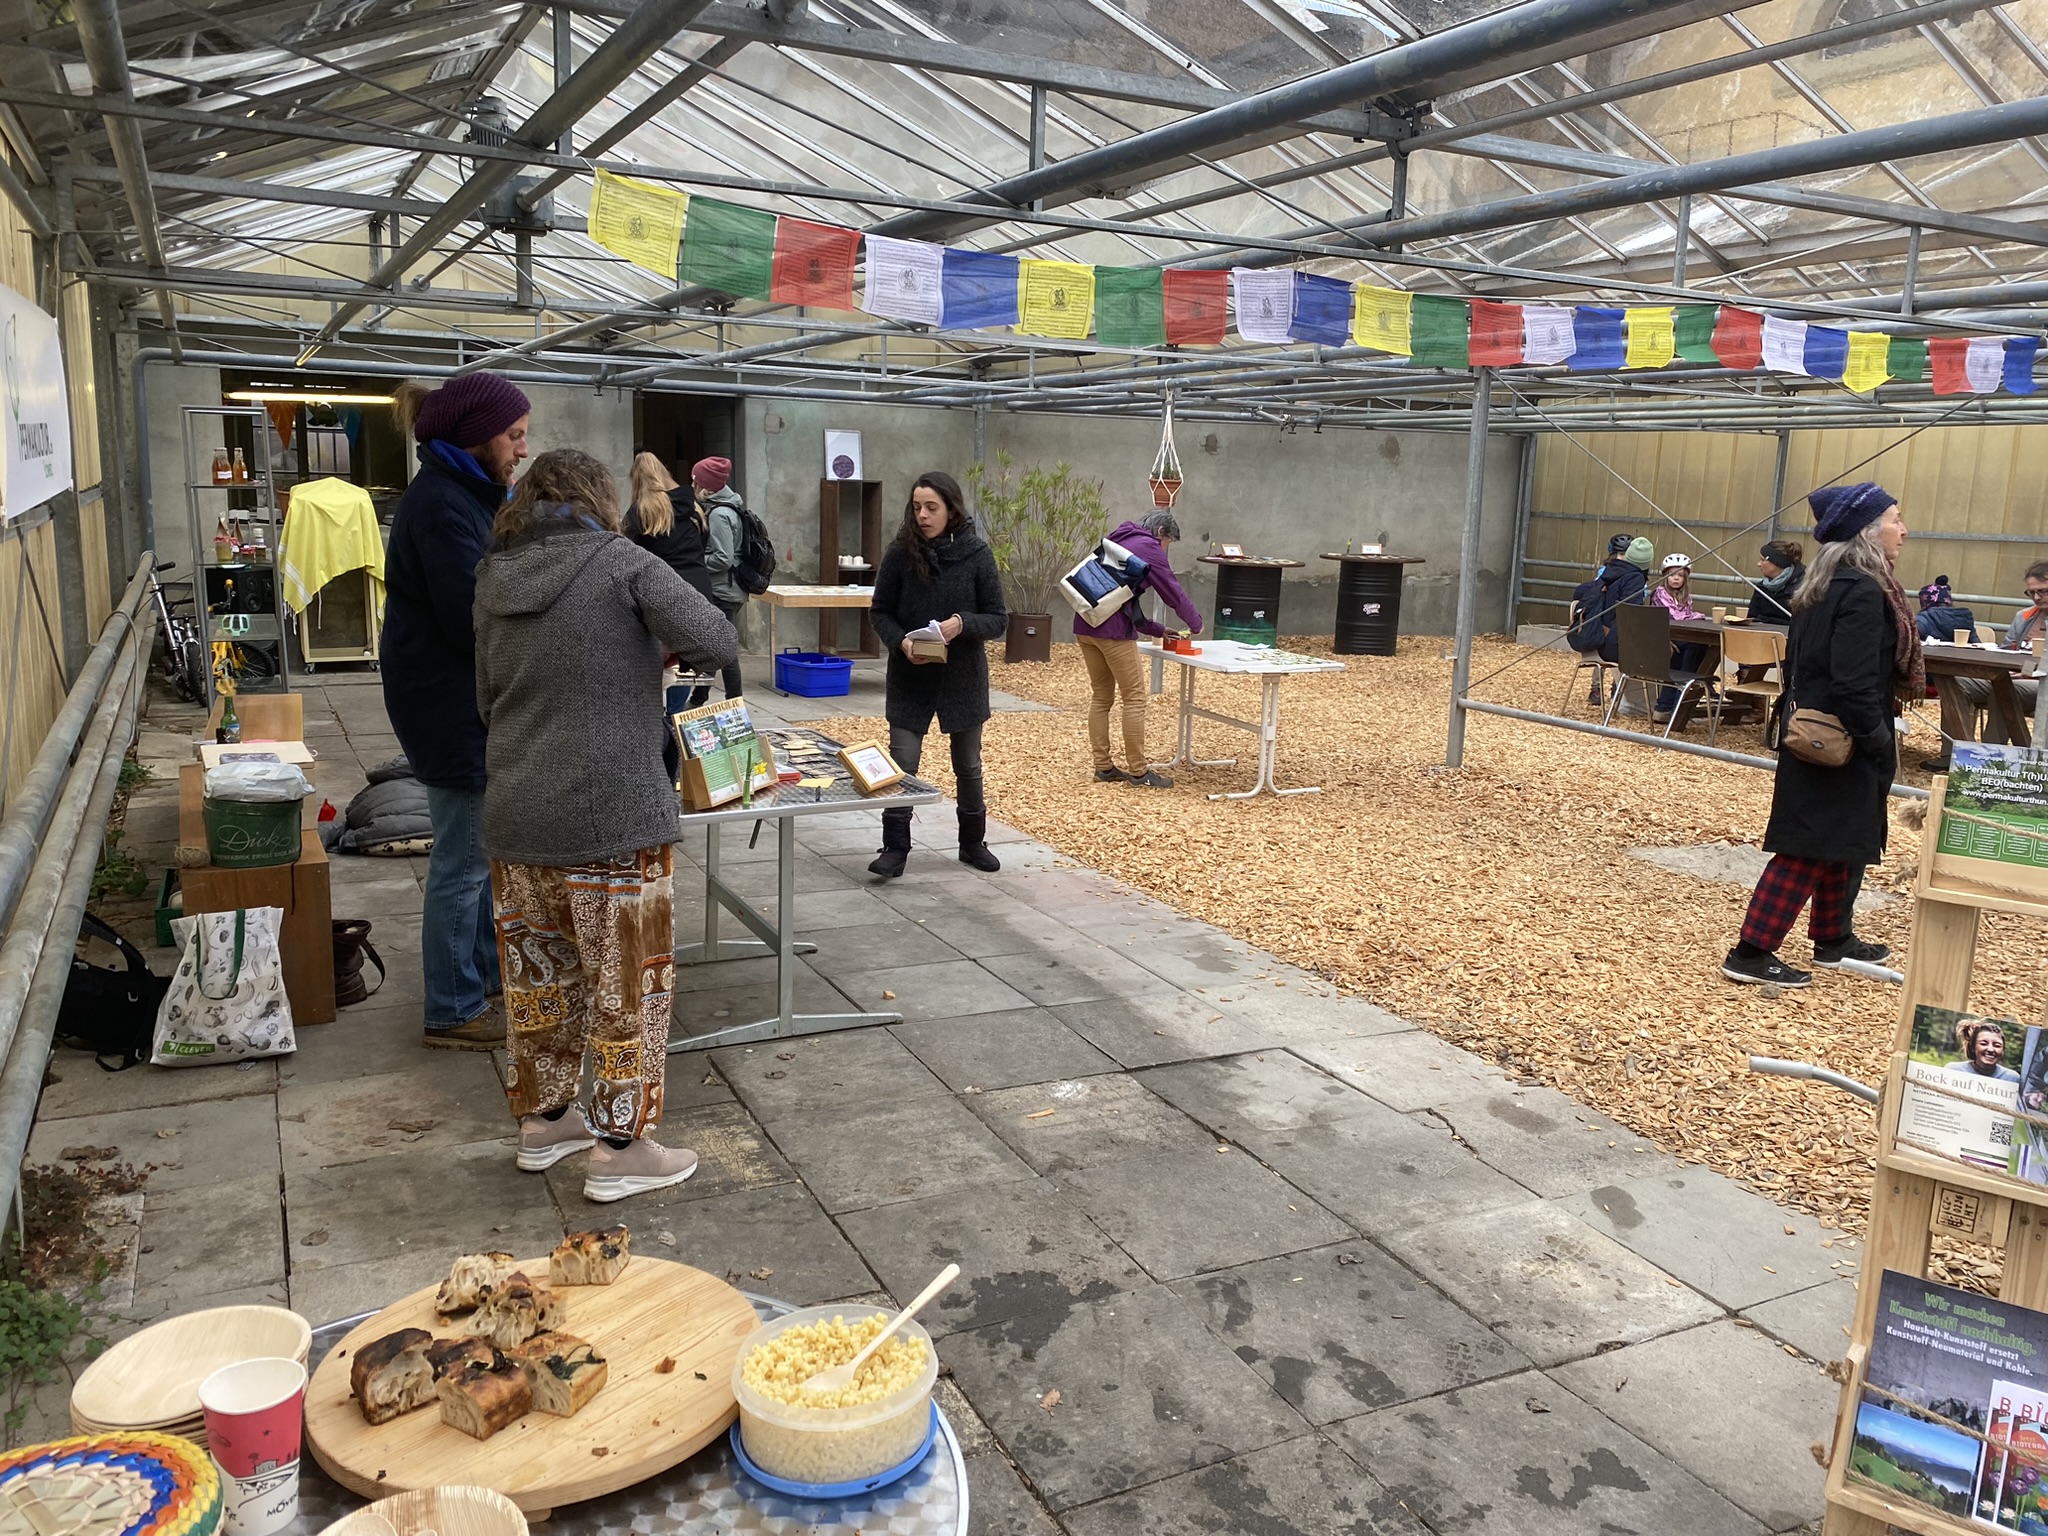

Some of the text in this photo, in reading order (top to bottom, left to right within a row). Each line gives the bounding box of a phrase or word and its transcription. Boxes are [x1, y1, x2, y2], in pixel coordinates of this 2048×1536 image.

[1965, 764, 2020, 779] Permakultur
[1981, 777, 2044, 793] BEO(bachten)
[217, 822, 291, 854] Dick
[1915, 1068, 1948, 1085] Bock
[1951, 1078, 1975, 1091] auf
[1964, 1203, 1975, 1217] HT
[1924, 1292, 2006, 1328] Wir machen
[1889, 1300, 2037, 1357] Kunststoff nachhaltig.
[1903, 1319, 2019, 1361] Haushalt-Kunststoff ersetzt
[1886, 1325, 2034, 1377] Kunststoff-Neumaterial und Kohle.
[2011, 1441, 2047, 1450] BIOTERRA
